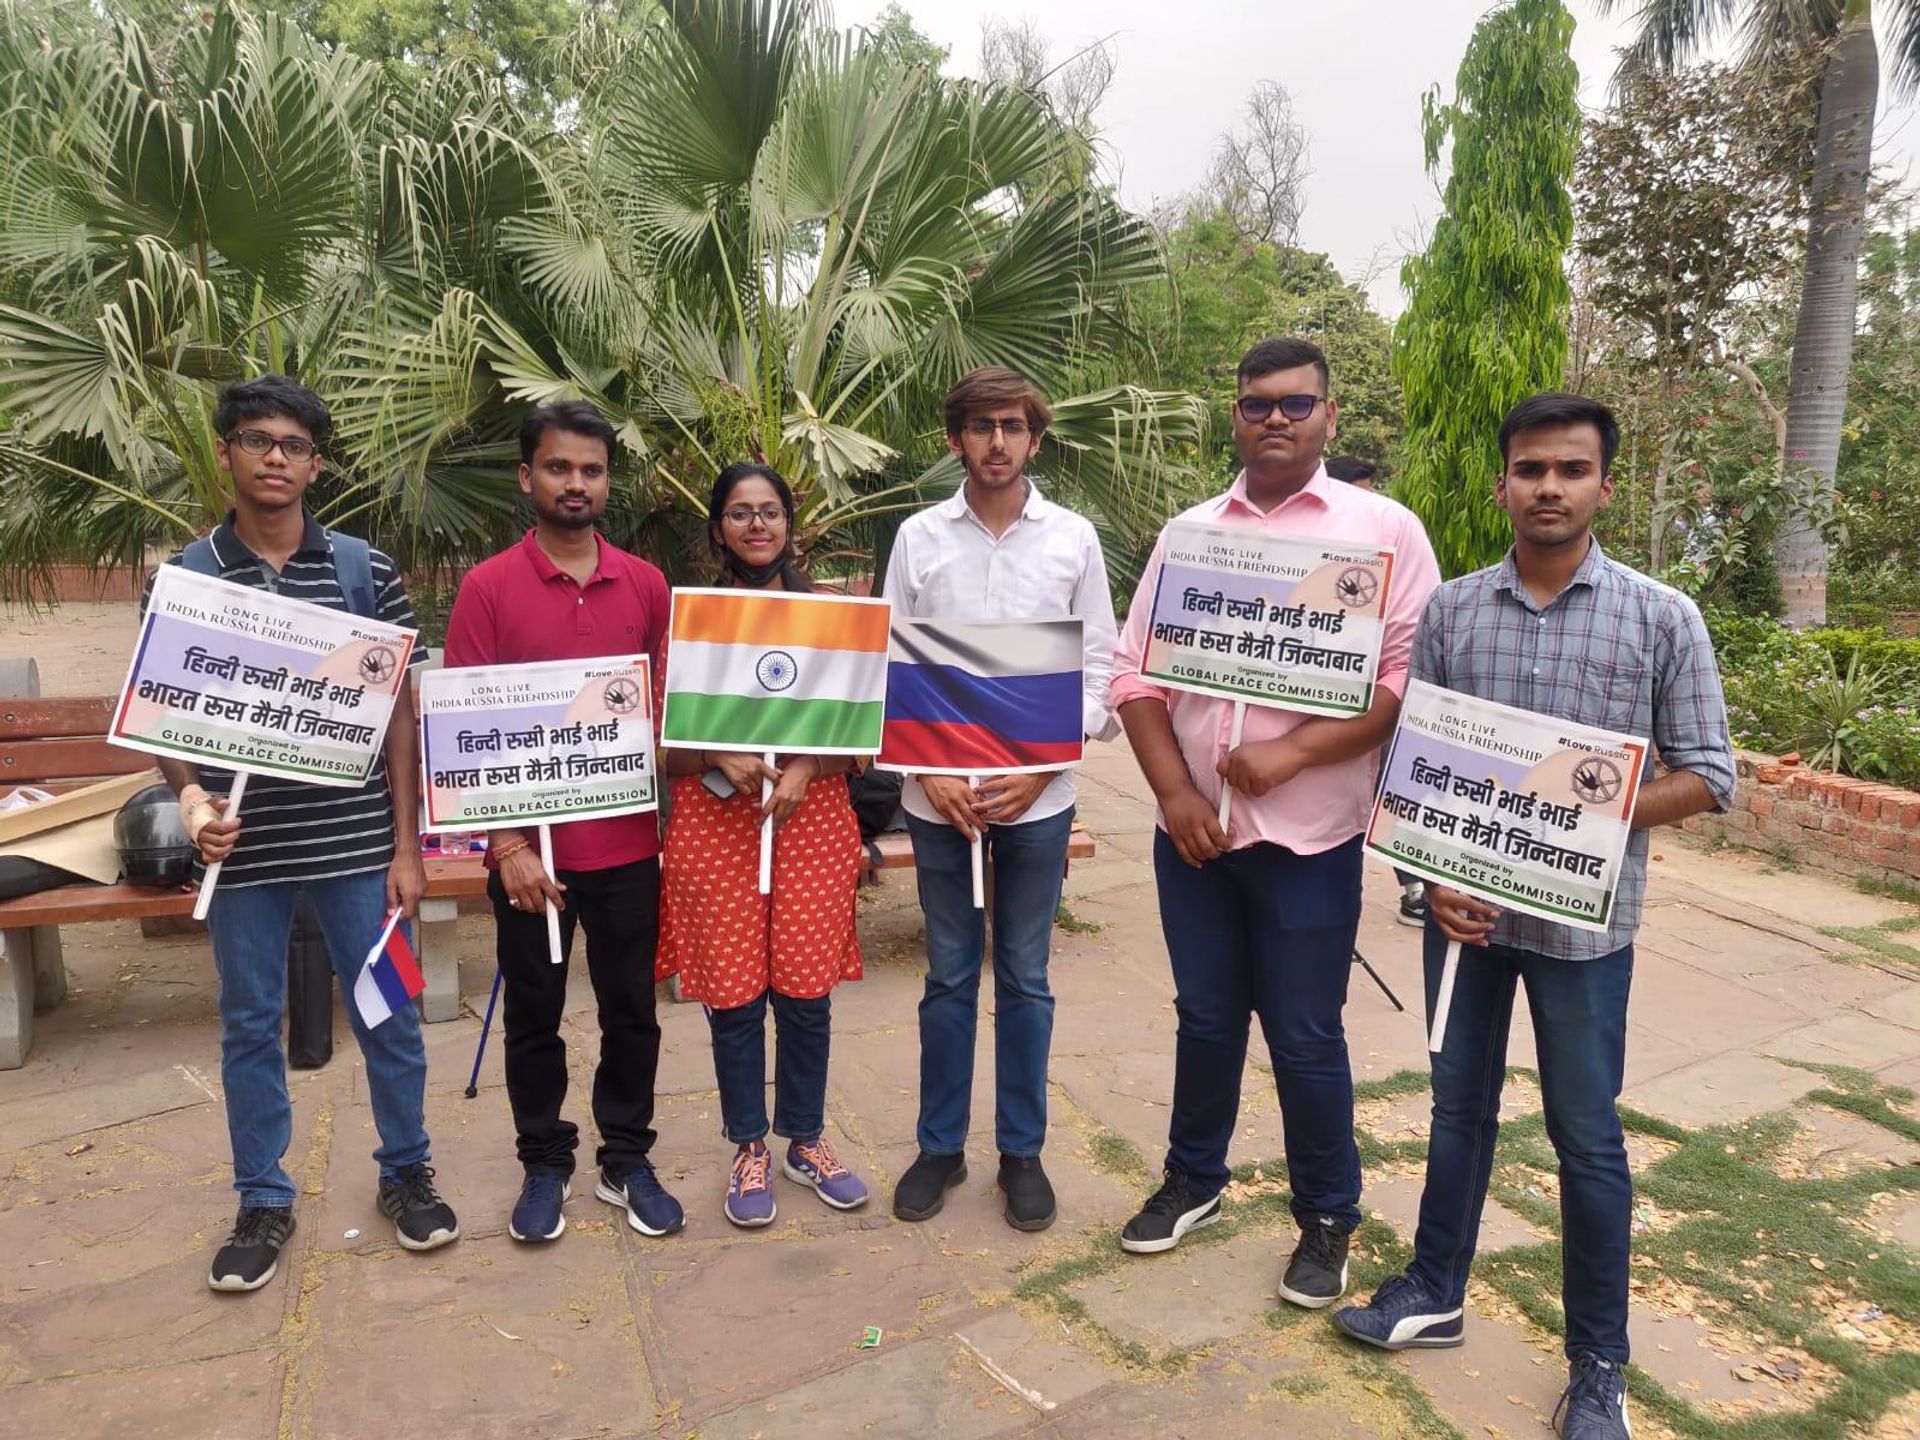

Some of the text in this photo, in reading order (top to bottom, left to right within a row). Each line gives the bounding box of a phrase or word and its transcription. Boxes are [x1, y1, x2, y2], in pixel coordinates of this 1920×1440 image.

[1171, 552, 1307, 577] INDIA RUSSIA FRIENDSHIP
[1207, 546, 1263, 560] LONG LIVE
[1322, 552, 1383, 567] #Love Russia
[223, 605, 293, 630] LONG LIVE
[1182, 587, 1224, 616] हिन्दी
[1269, 605, 1305, 628] भाई
[1308, 609, 1345, 634] भाई
[165, 602, 336, 652] INDIA RUSSIA FRIENDSHIP
[351, 629, 404, 647] #Love Russia
[1154, 622, 1367, 674] भारत रूस मैत्री जिन्दाबाद
[182, 646, 240, 682] हिन्दी
[290, 675, 330, 701] भाई
[329, 683, 364, 708] भाई
[585, 668, 640, 679] #Love Russia
[1172, 665, 1360, 704] GLOBAL PEACE COMMISSION
[1277, 672, 1287, 681] by
[432, 690, 576, 708] INDIA RUSSIA FRIENDSHIP
[472, 684, 530, 695] LONG LIVE
[138, 678, 376, 747] भारत रूस मैत्री जिन्दाबाद
[1440, 713, 1496, 737] LONG LIVE
[291, 743, 301, 752] by
[457, 729, 502, 753] हिन्दी
[550, 721, 582, 747] भाई
[587, 718, 619, 742] भाई
[1406, 714, 1542, 763] INDIA RUSSIA FRIENDSHIP
[162, 729, 363, 774] GLOBAL PEACE COMMISSION
[1558, 737, 1630, 761] #Love Russia
[435, 752, 645, 789] भारत रूस मैत्री जिन्दाबाद
[464, 789, 648, 816] GLOBAL PEACE COMMISSION
[571, 788, 581, 796] by
[1410, 757, 1451, 792] हिन्दी
[1497, 790, 1538, 819] भाई
[1538, 799, 1582, 832] भाई
[1383, 791, 1606, 879] भारत रूस मैत्री जिन्दाबाद
[1393, 840, 1596, 913] GLOBAL PEACE COMMISSION
[1503, 866, 1513, 876] by
